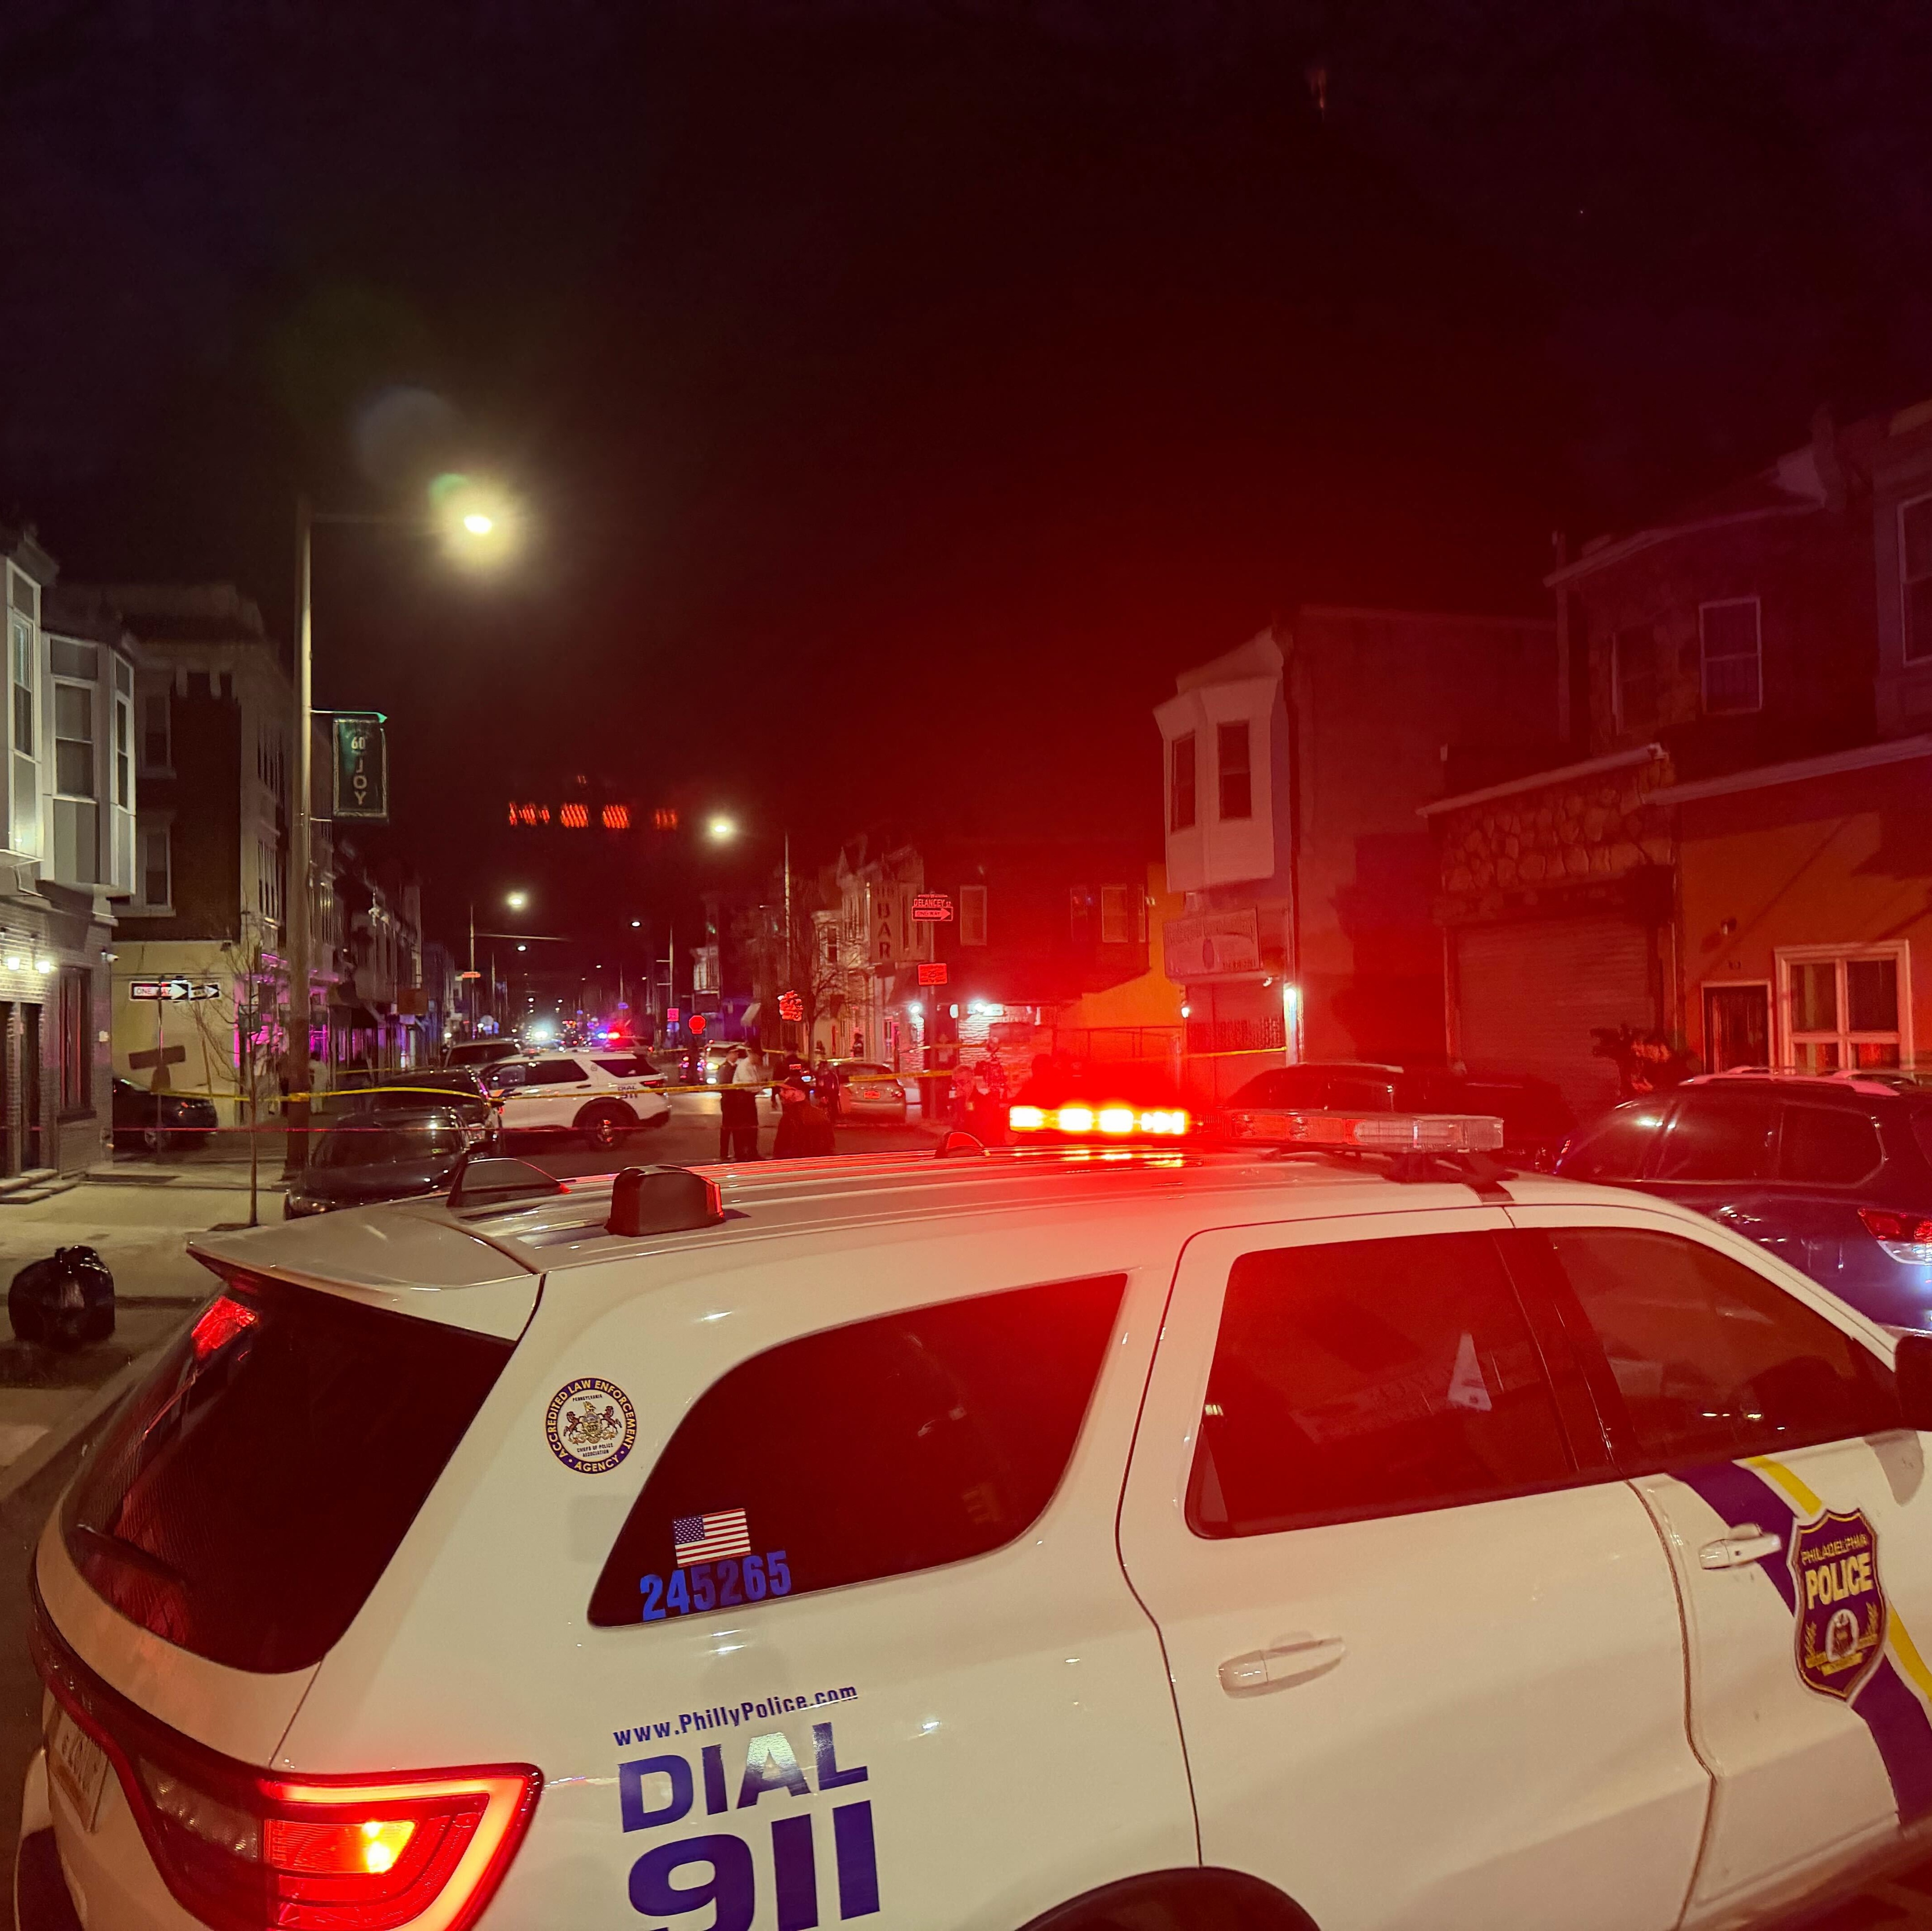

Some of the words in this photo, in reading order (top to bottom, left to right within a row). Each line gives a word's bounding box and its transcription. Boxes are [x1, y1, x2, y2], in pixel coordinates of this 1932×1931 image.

[351, 736, 366, 750] 60
[353, 758, 367, 806] JOY
[913, 899, 945, 907] DELANCEY
[877, 902, 891, 959] BAR
[547, 1391, 568, 1458] ACCREDITED
[568, 1379, 591, 1394] LAW
[594, 1380, 635, 1449] ENFORCEMENT
[572, 1394, 603, 1402] PENNSYLVANIA
[574, 1455, 619, 1472] AGENCY
[582, 1449, 609, 1457] ASSOCIATION
[1800, 1533, 1868, 1566] PHILADELPHIA
[640, 1550, 791, 1621] 245265
[1805, 1552, 1873, 1610] POLICE
[613, 1685, 858, 1747] www.PhillyPolice.com
[617, 1721, 868, 1833] DIAL
[628, 1799, 880, 1931] 911
